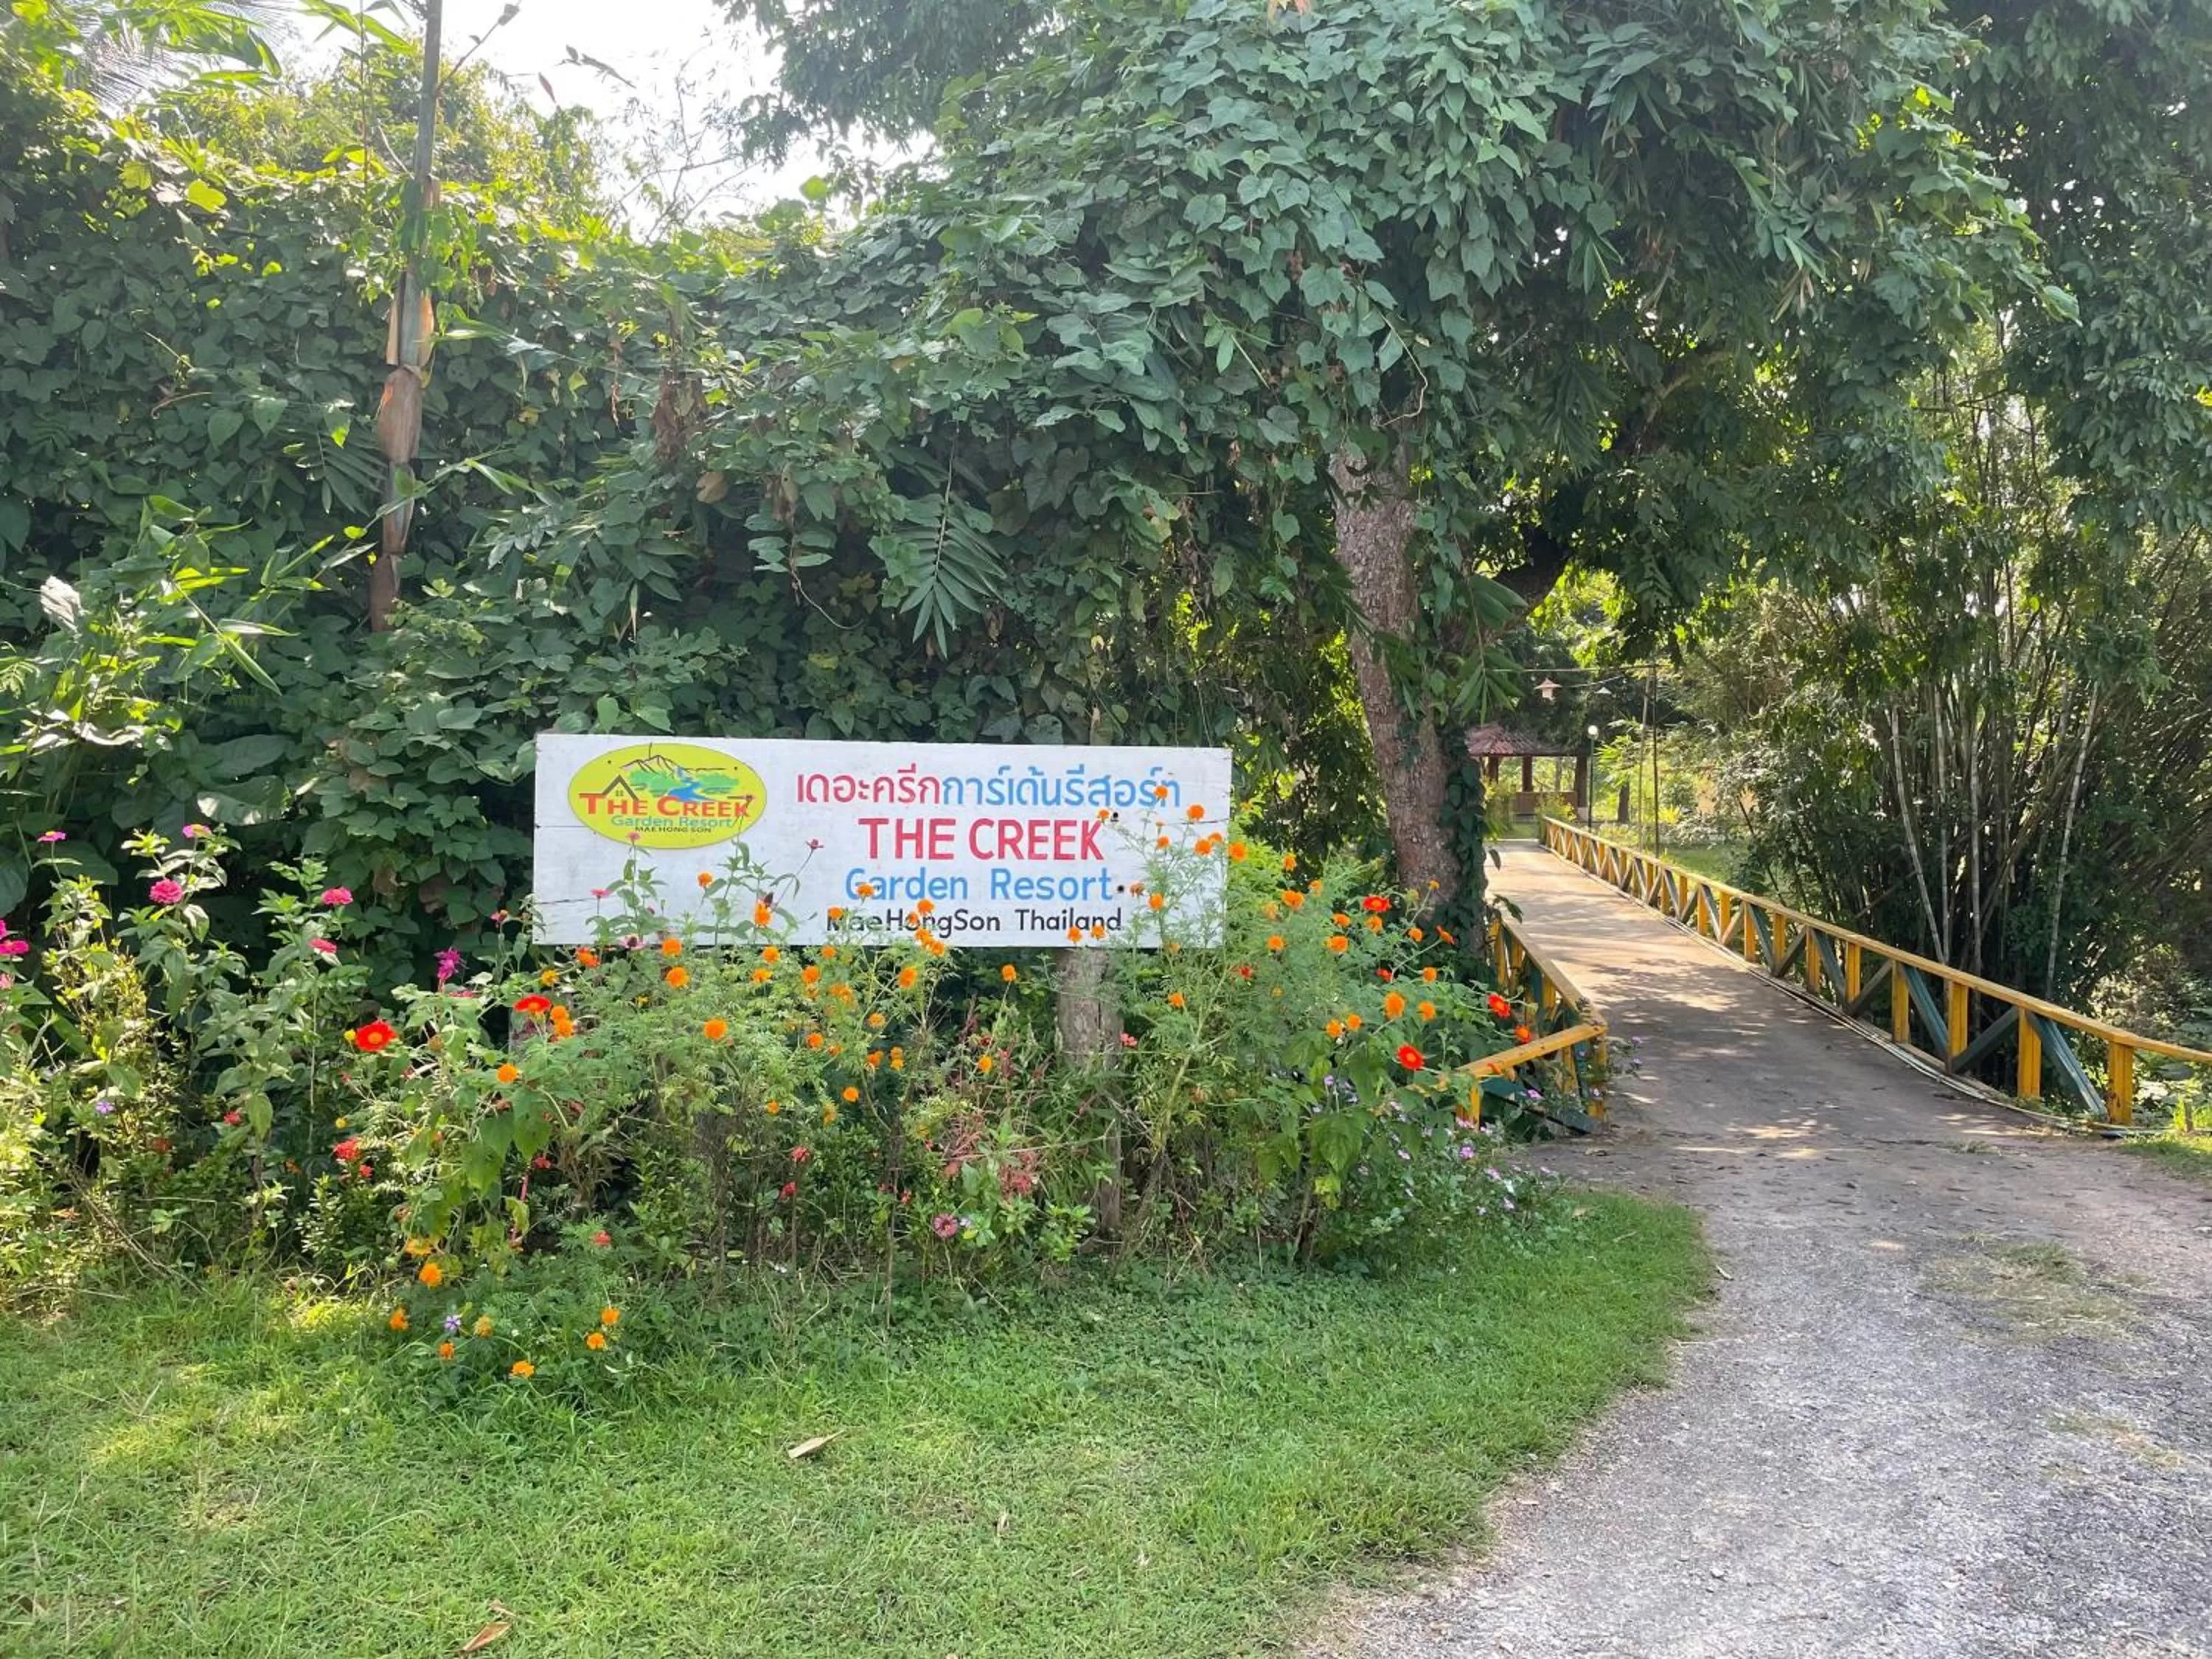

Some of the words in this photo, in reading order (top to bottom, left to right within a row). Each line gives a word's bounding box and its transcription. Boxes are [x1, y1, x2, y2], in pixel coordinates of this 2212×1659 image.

[579, 793, 648, 815] THE
[657, 795, 750, 818] CREEK
[611, 815, 673, 827] Garden
[679, 816, 732, 827] Resort
[858, 818, 956, 860] THE
[968, 818, 1104, 860] CREEK
[846, 867, 968, 900] Garden
[990, 867, 1113, 901] Resort
[1015, 908, 1121, 931] Thailand
